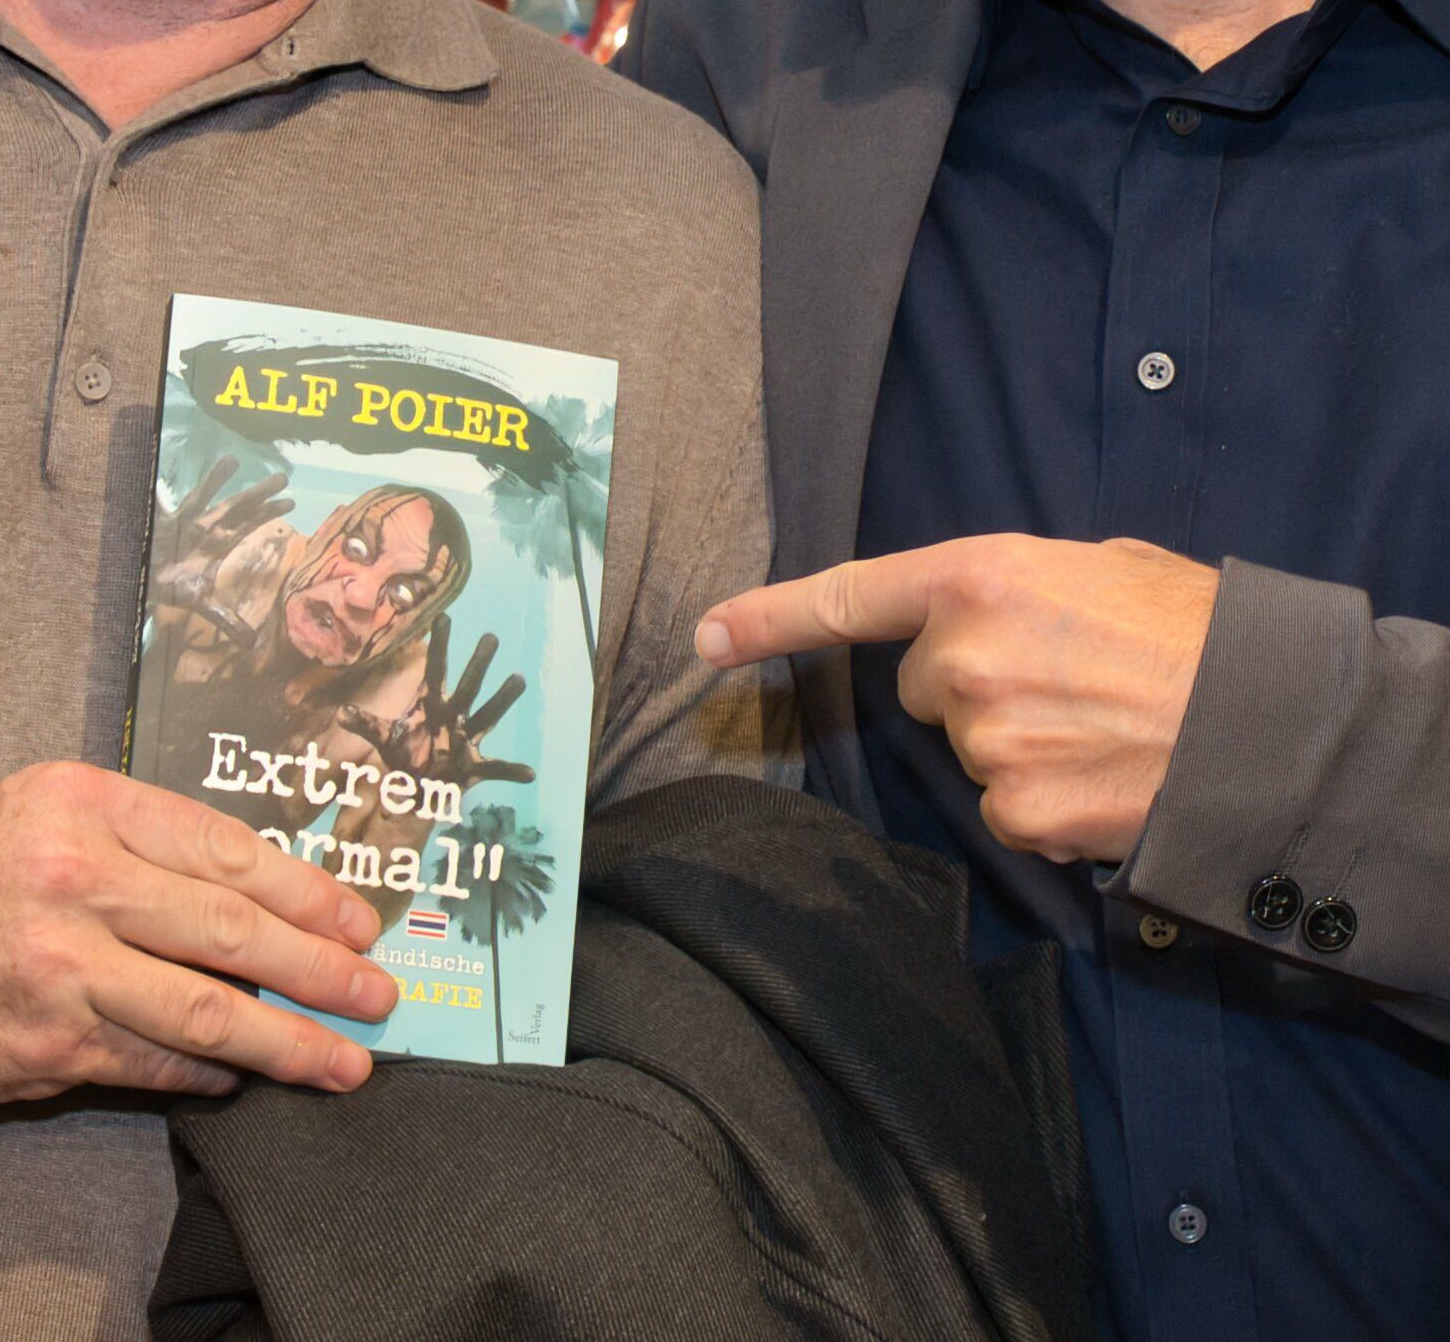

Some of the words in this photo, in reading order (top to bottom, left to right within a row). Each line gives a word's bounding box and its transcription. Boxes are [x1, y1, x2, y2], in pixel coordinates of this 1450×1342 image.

[215, 365, 338, 417] ALF
[352, 382, 530, 451] POIER
[202, 732, 463, 824] Extrem
[257, 826, 505, 900] ormal"
[368, 942, 486, 976] ändische
[394, 977, 483, 1009] RAFIE
[529, 1003, 545, 1036] Verlag
[507, 1030, 541, 1046] Seifert
